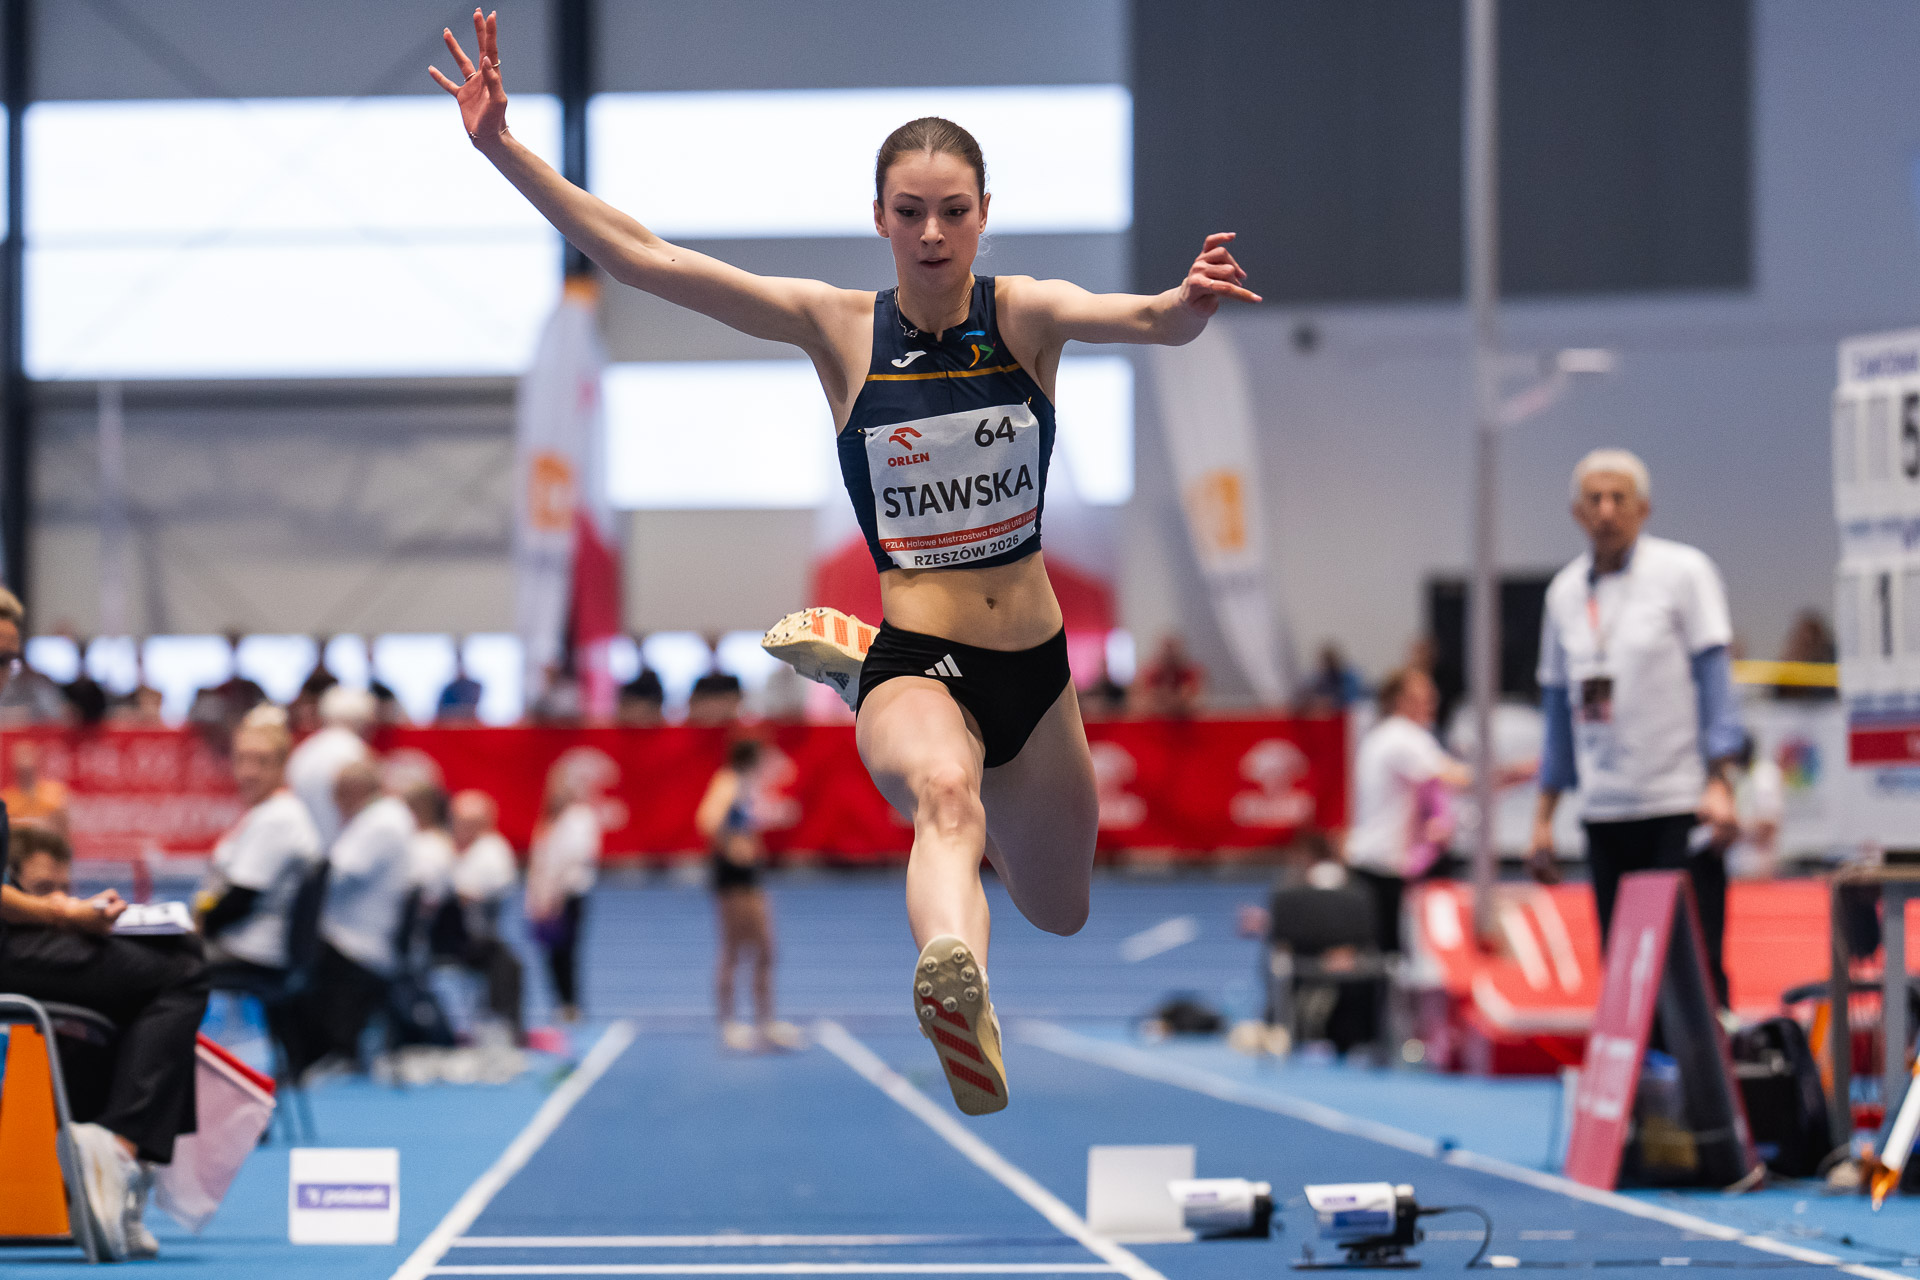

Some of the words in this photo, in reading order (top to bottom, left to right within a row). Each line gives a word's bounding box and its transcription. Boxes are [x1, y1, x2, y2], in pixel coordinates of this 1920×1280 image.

[974, 416, 1017, 448] 64
[887, 452, 930, 467] ORLEN
[882, 464, 1034, 519] STAWSKA
[885, 541, 905, 550] PZLA
[906, 540, 937, 549] Halowe
[938, 530, 988, 545] Mistrzostwa
[989, 521, 1011, 535] Polski
[914, 545, 986, 566] RZESZÓW
[989, 534, 1019, 554] 2026
